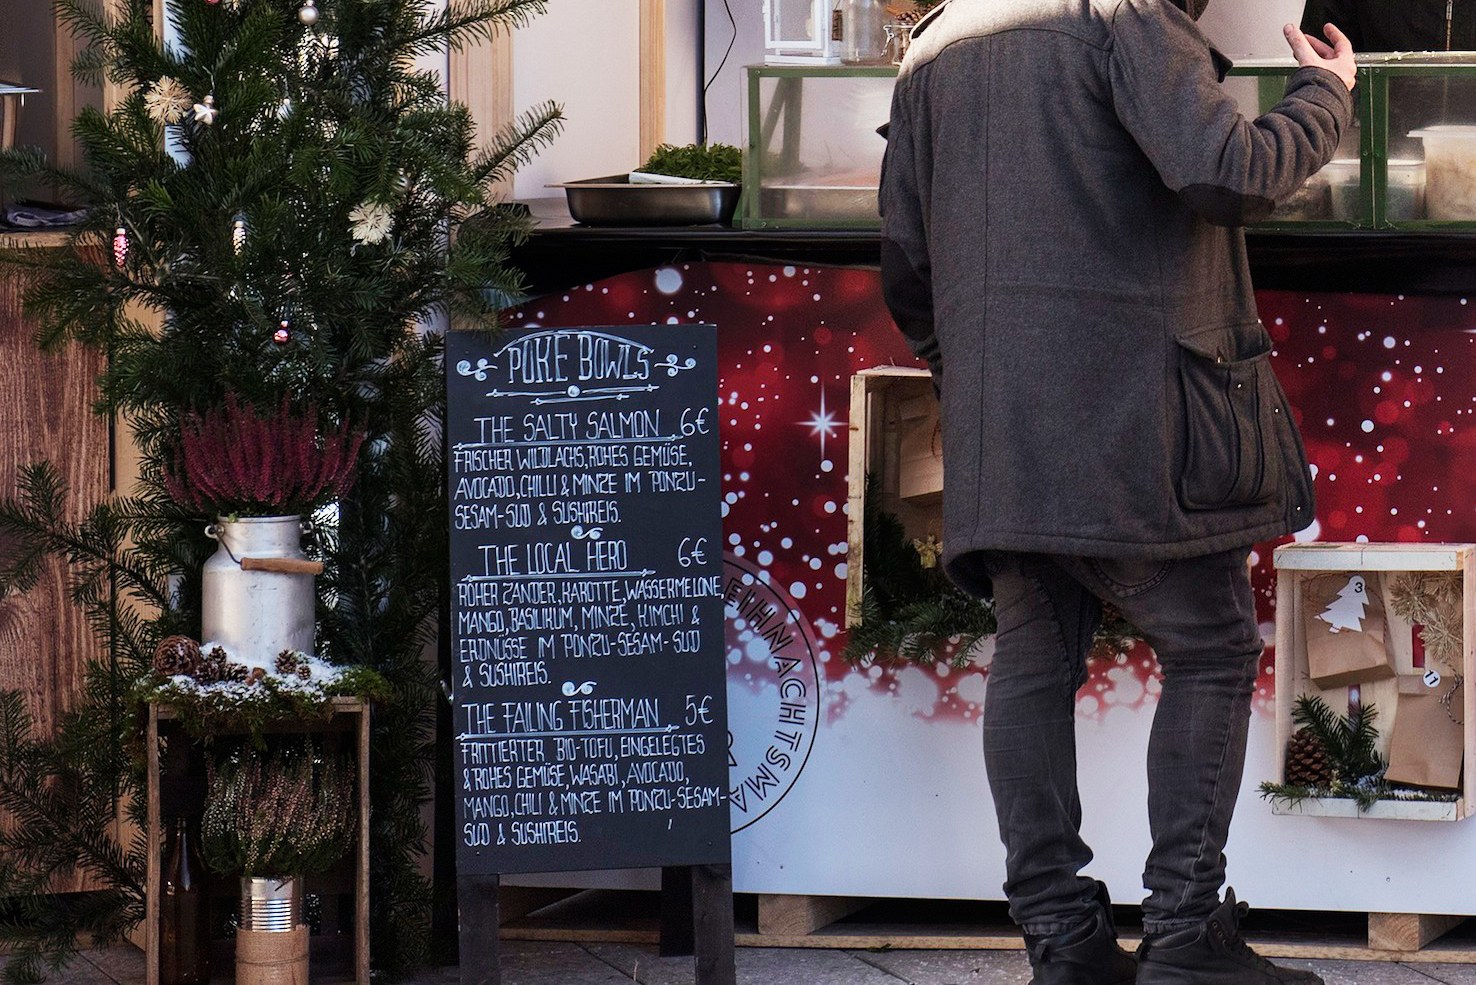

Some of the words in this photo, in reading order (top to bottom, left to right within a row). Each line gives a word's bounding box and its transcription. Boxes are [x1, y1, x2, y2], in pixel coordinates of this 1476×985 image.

[508, 334, 570, 383] POKE
[578, 334, 649, 381] BOWLS
[474, 416, 514, 443] THE
[524, 412, 578, 441] SALTY
[586, 408, 660, 439] SALMON
[454, 449, 513, 472] FRISCHER
[573, 473, 617, 495] MINZE
[625, 472, 641, 493] IM
[455, 504, 531, 529] SESAM-SUD
[537, 502, 548, 526] &
[478, 544, 520, 576] THE
[526, 542, 579, 575] LOCAL
[586, 540, 627, 572] HERO
[457, 582, 498, 607] ROHER
[1354, 581, 1363, 594] 3
[638, 604, 683, 627] KIMCHI
[691, 604, 700, 625] &
[460, 634, 527, 663] ERDNÜSSE
[539, 636, 555, 659] IM
[462, 666, 473, 688] &
[462, 702, 496, 734] THE
[502, 700, 563, 733] FAILING
[569, 698, 659, 730] FISHERMAN
[460, 739, 545, 764] FRITTIERTER
[621, 734, 705, 757] EINGELEGTES
[471, 767, 512, 790] ROHES
[549, 792, 558, 815] &
[561, 791, 601, 815] MINZE
[609, 789, 624, 812] IM
[464, 823, 490, 847] SUD
[497, 822, 505, 845] &
